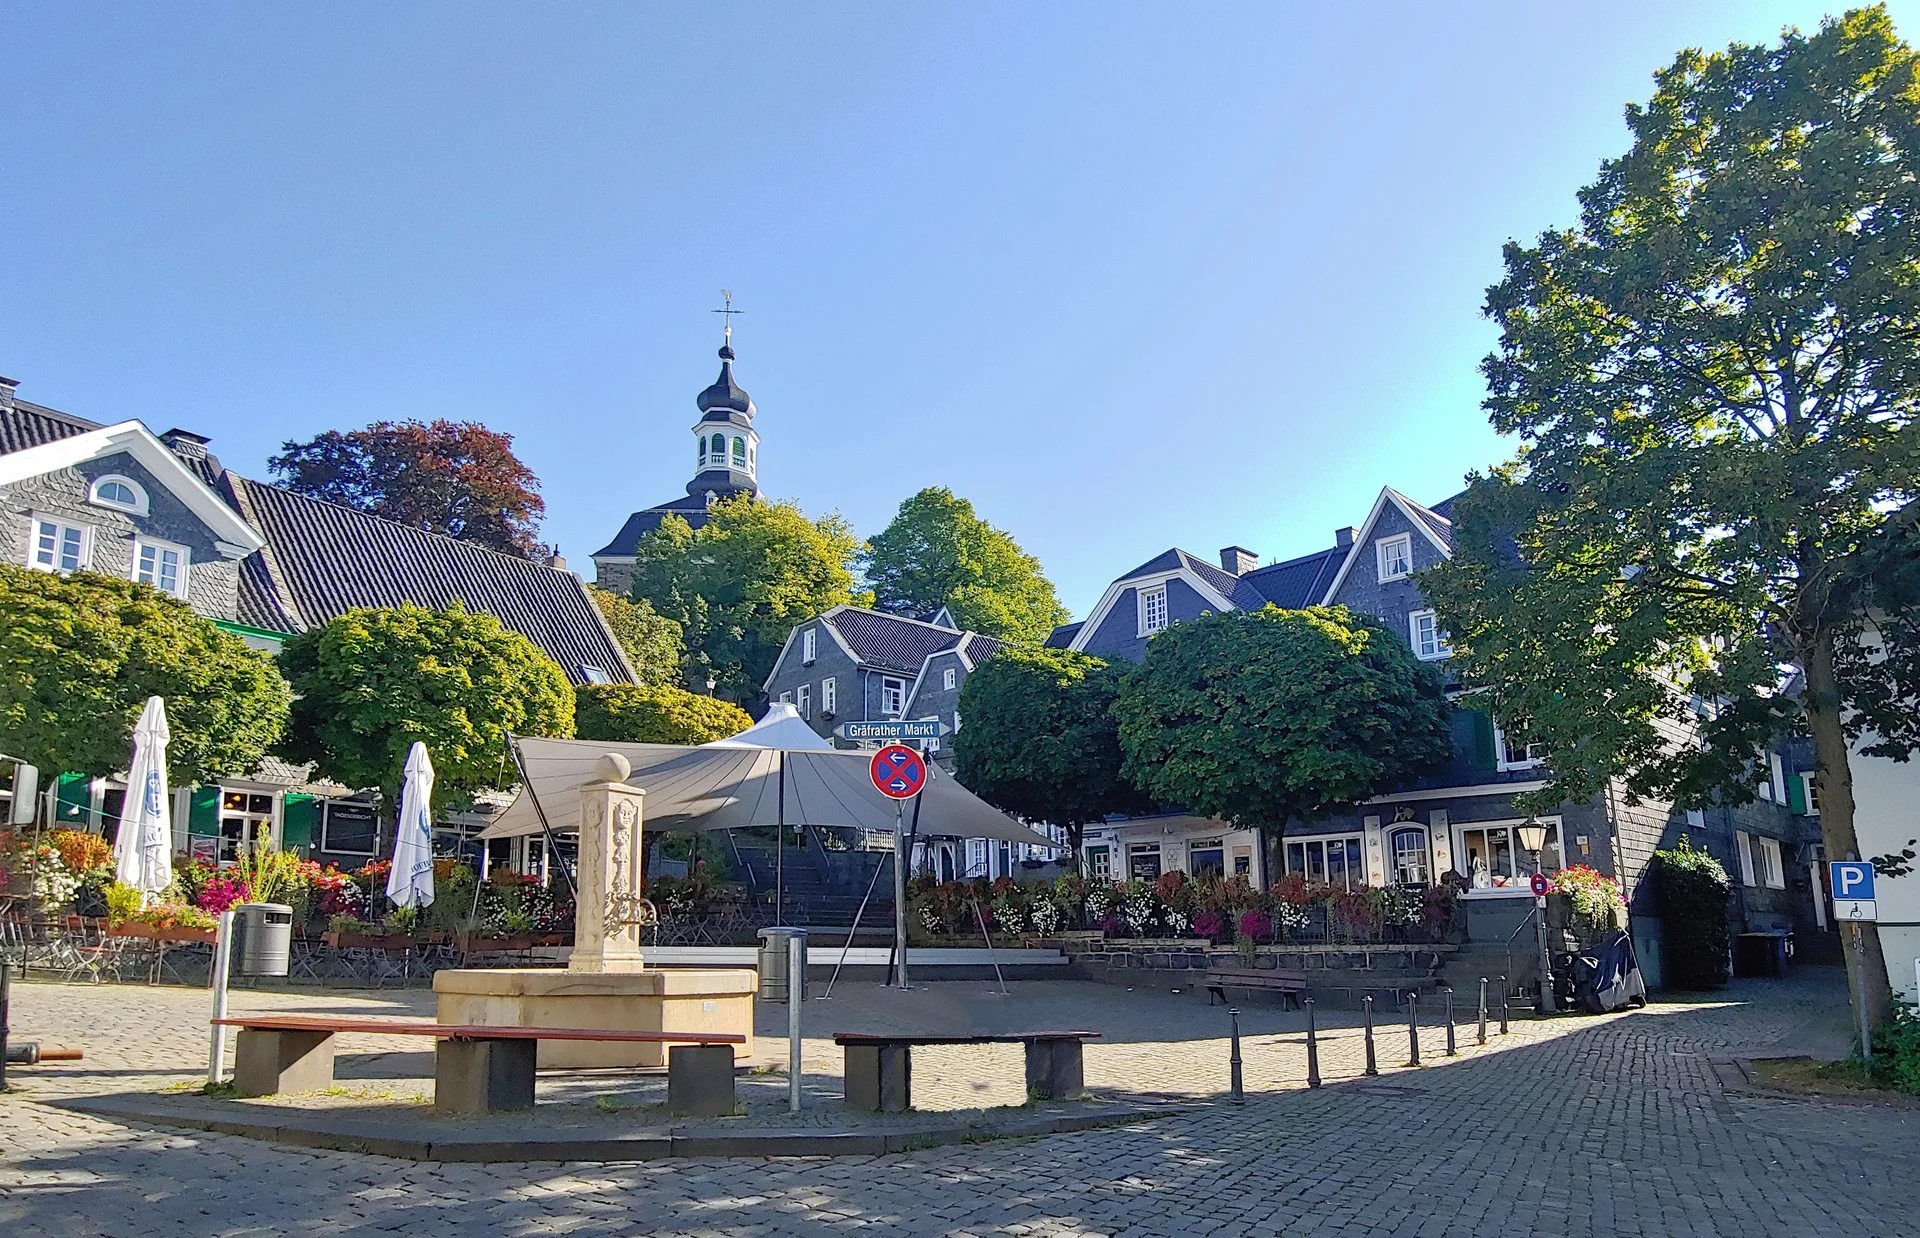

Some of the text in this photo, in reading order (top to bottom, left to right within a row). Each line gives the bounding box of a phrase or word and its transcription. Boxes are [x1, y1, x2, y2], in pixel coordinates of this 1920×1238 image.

[849, 722, 934, 737] Gräfrather Markt
[1840, 866, 1864, 895] P
